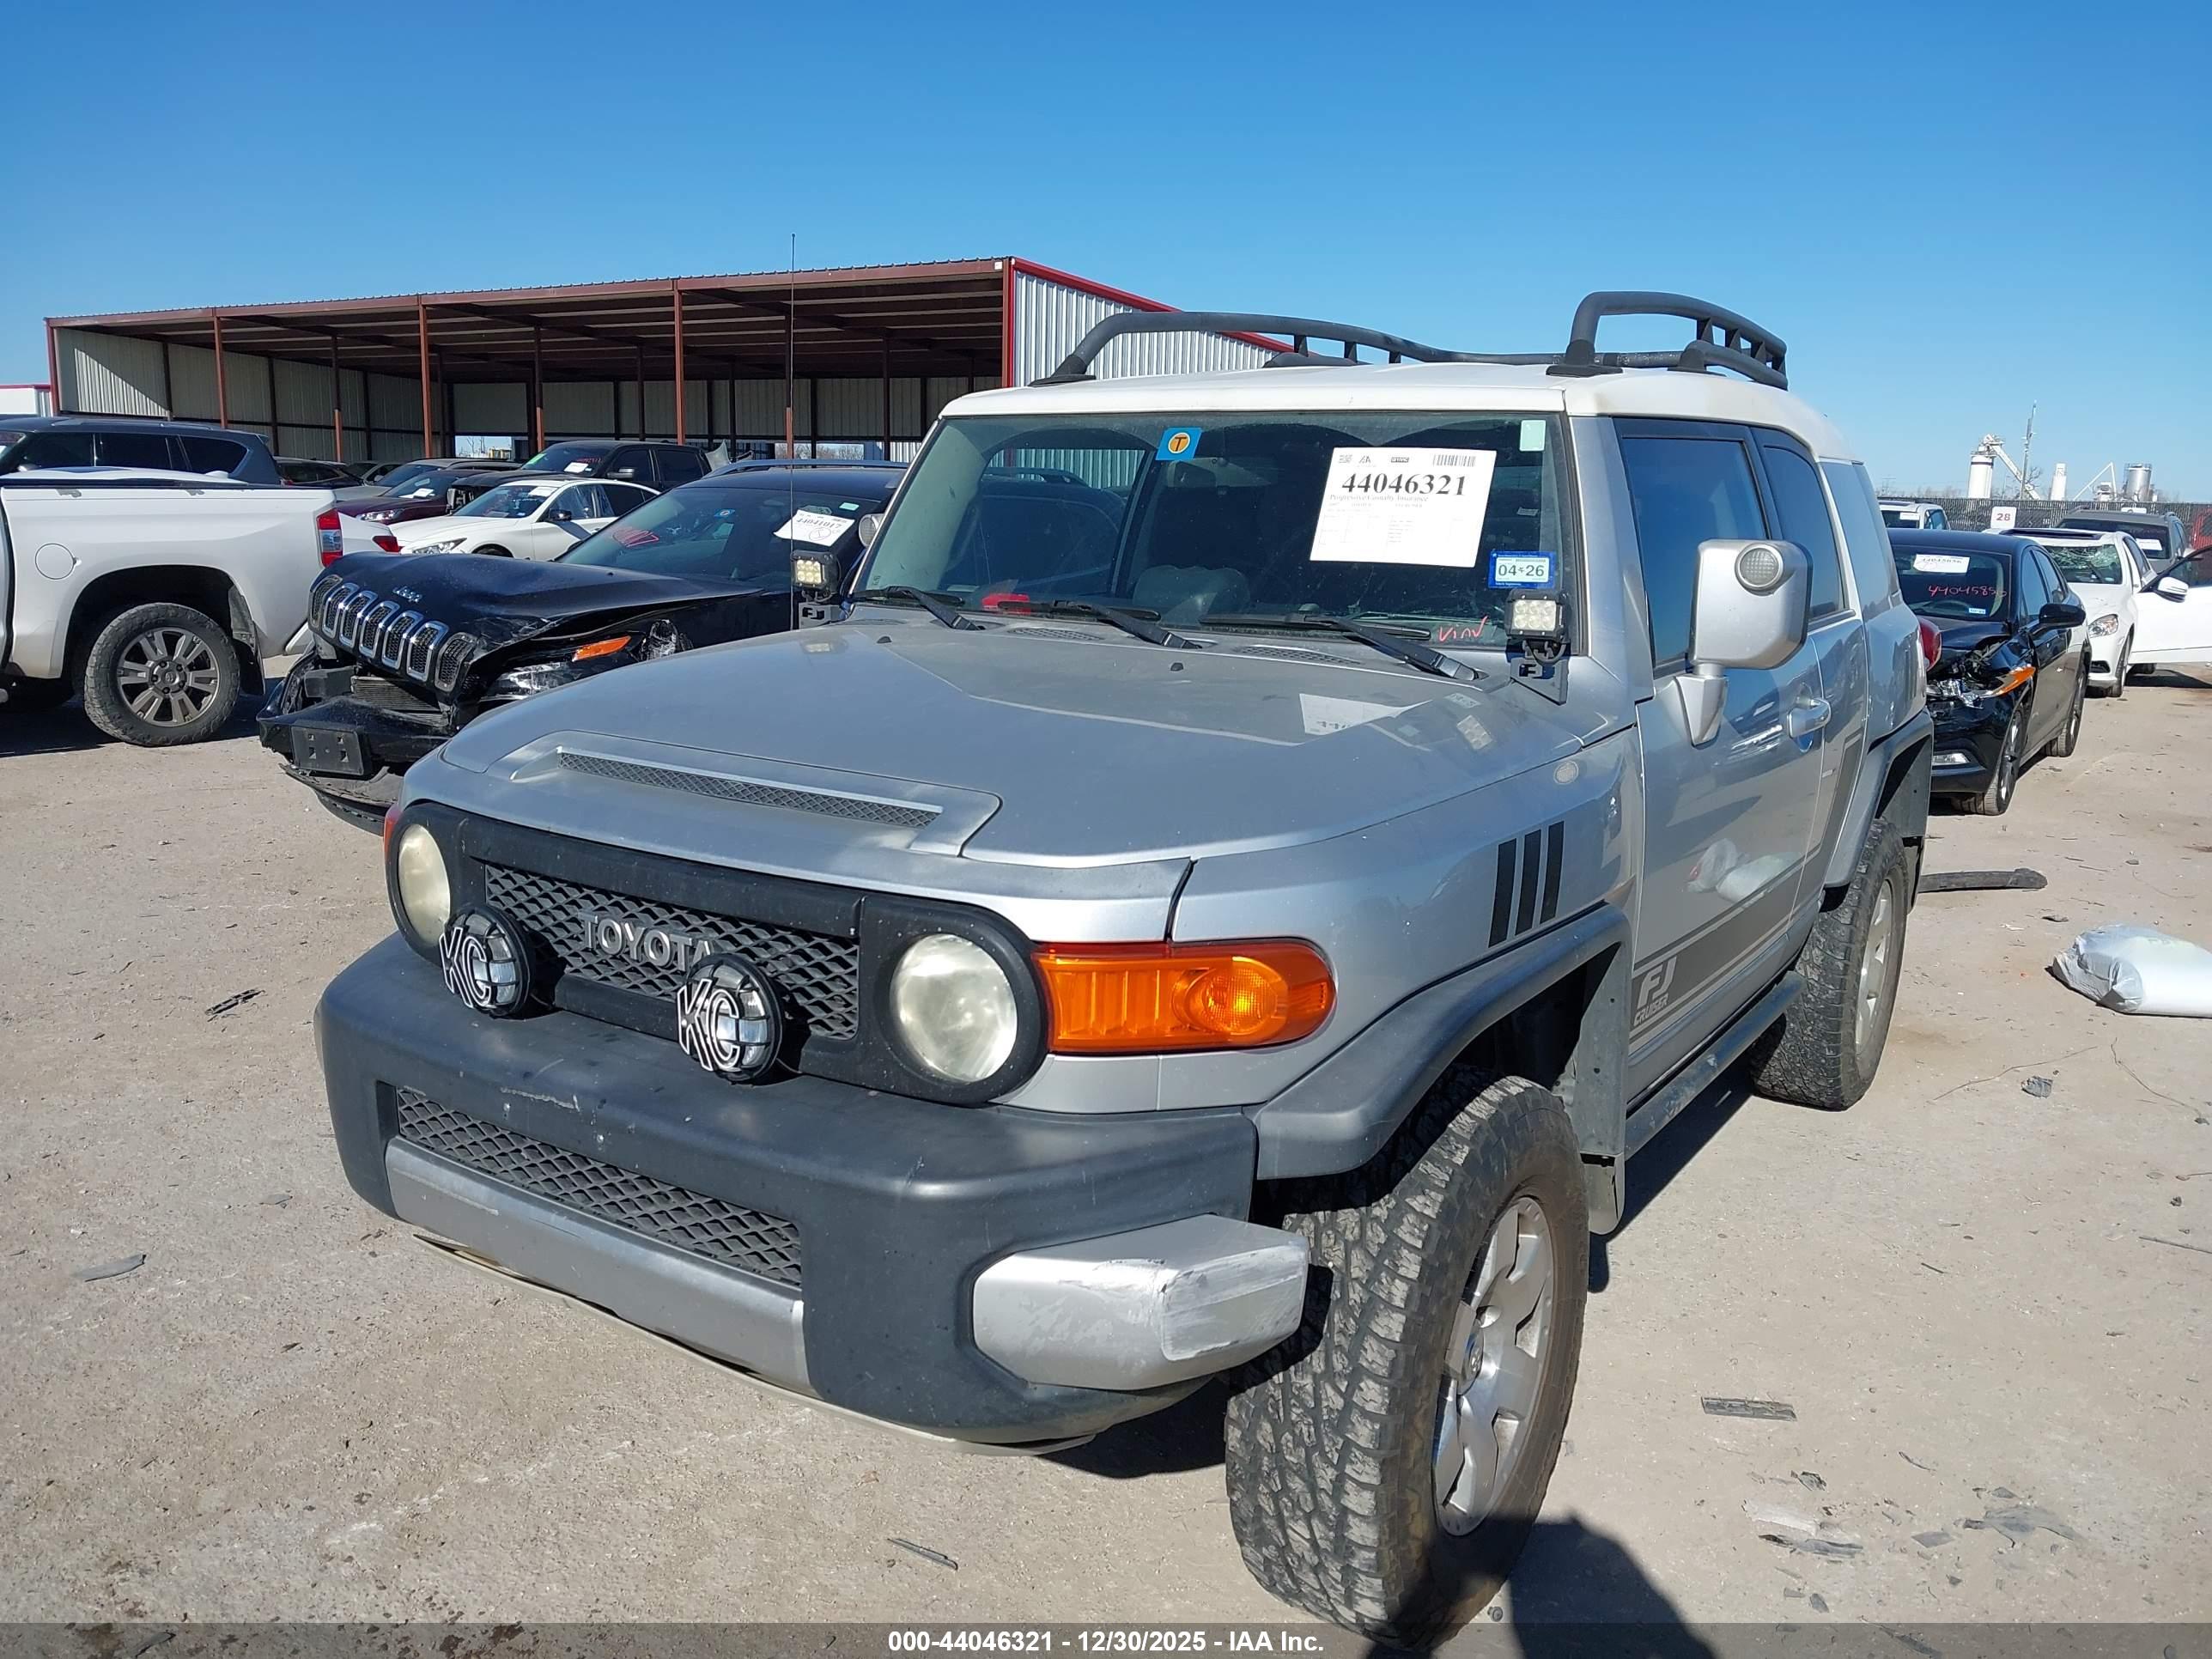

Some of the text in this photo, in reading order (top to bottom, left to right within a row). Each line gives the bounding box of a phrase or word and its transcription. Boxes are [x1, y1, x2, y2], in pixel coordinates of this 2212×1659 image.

[1341, 473, 1467, 495] 44046321
[1996, 513, 2011, 521] 28
[1498, 564, 1545, 577] 04 26
[577, 910, 712, 973] TOYOTA
[439, 927, 492, 1009] KC
[1637, 956, 1677, 1011] FJ
[677, 977, 742, 1072] KC
[1633, 992, 1669, 1027] CRUISER
